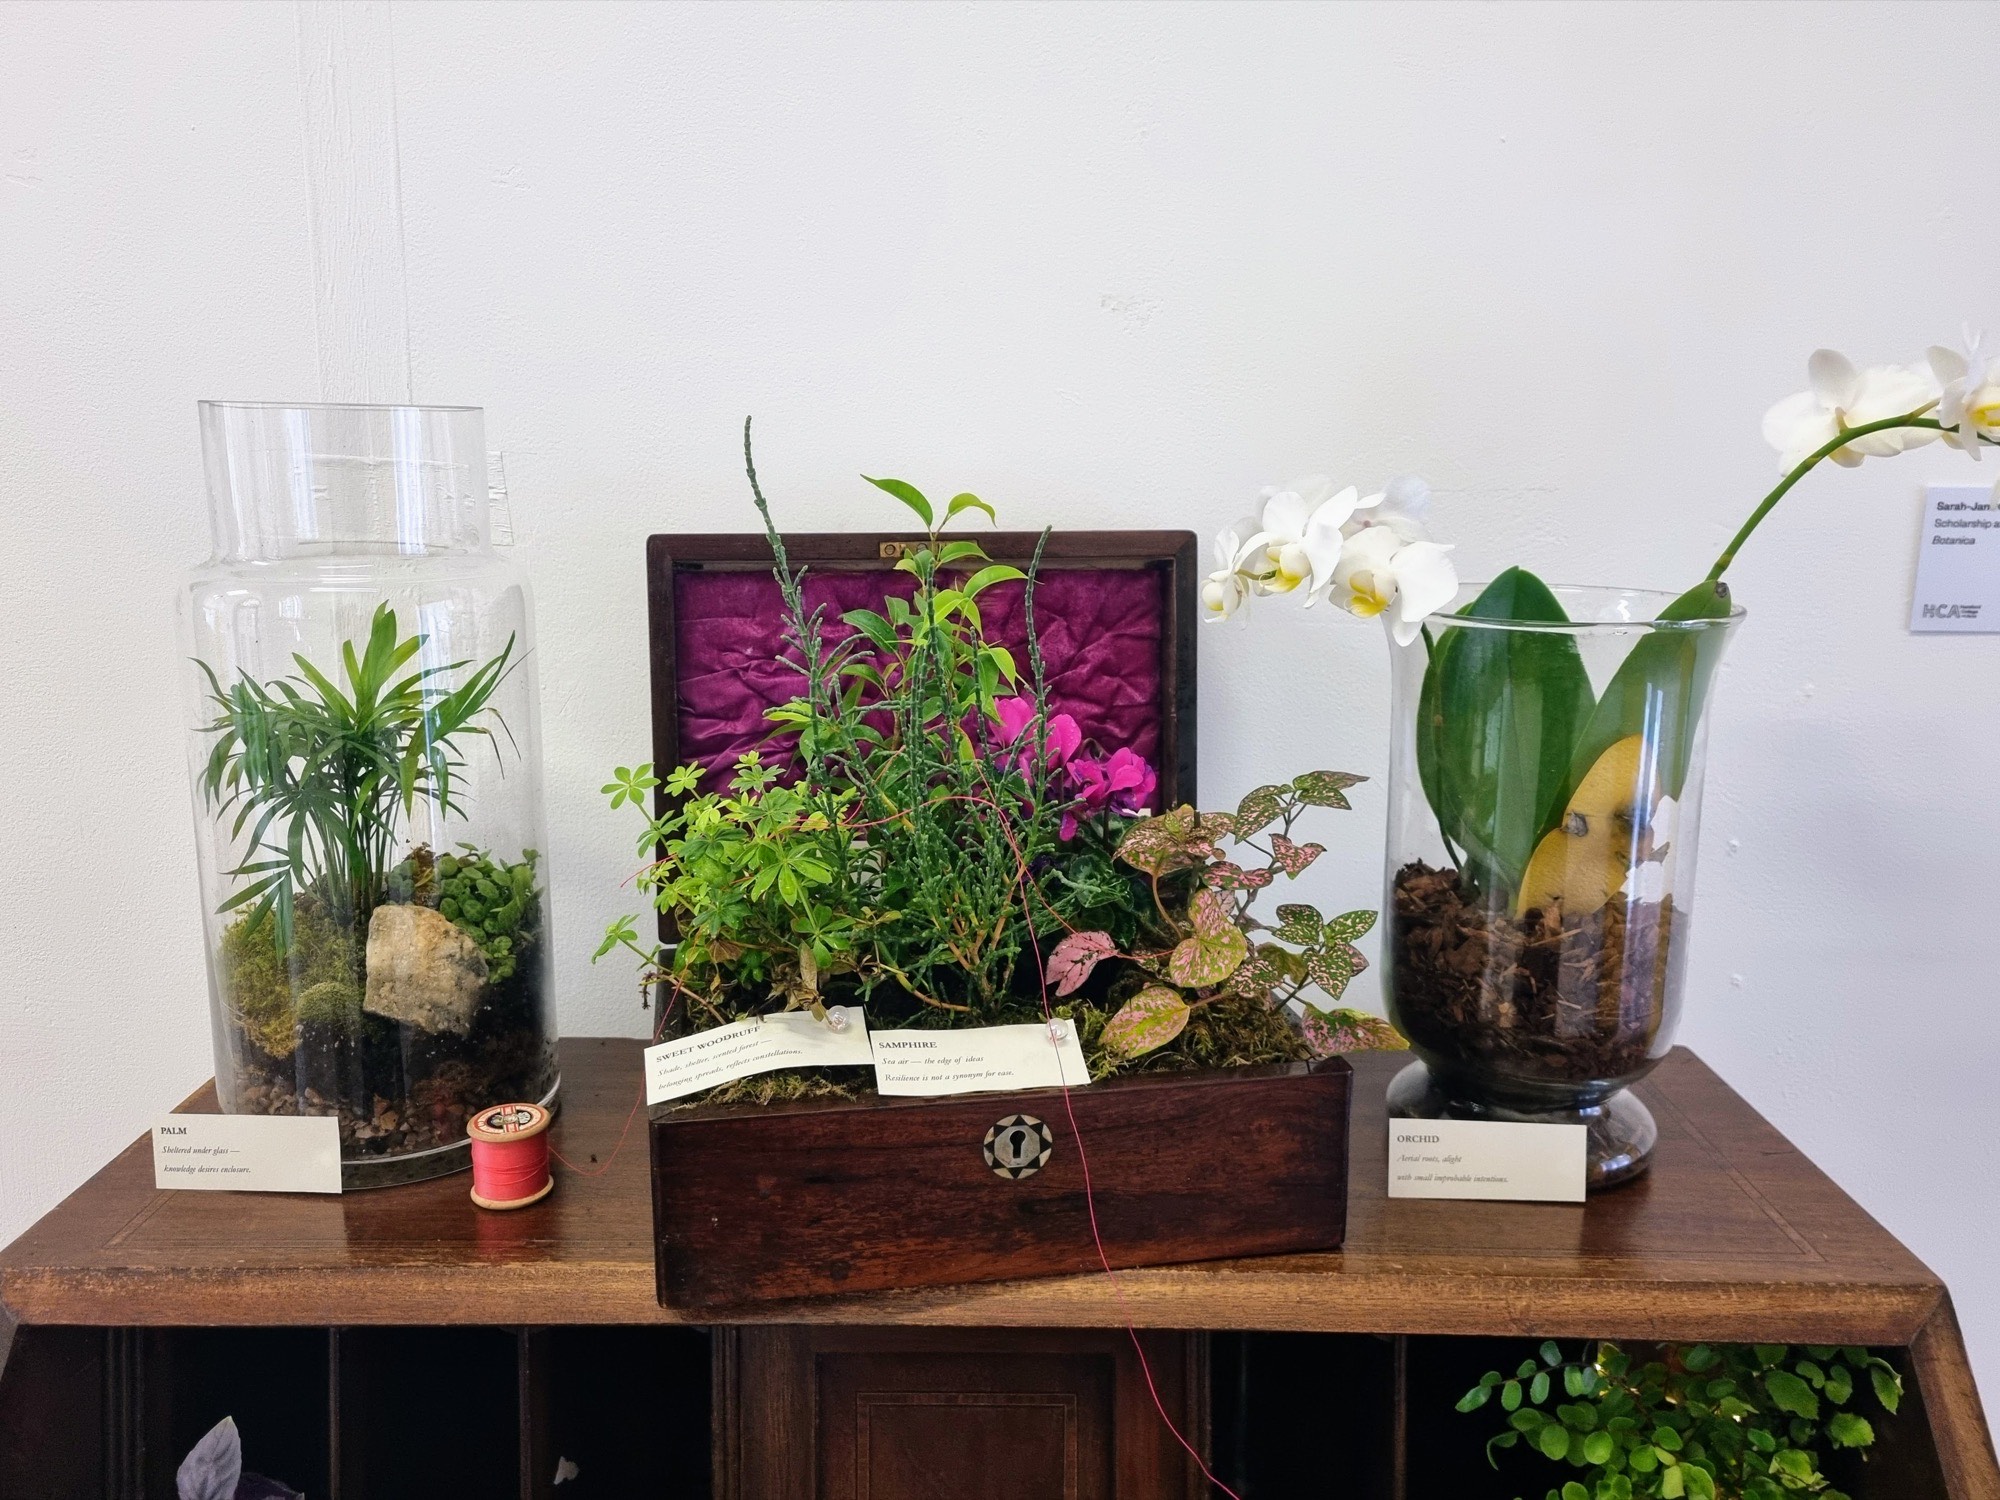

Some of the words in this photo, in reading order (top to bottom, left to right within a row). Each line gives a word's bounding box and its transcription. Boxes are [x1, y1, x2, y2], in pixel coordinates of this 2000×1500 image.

[1936, 501, 1991, 511] Sarah-Jan
[1934, 518, 1992, 530] Scholarship
[1932, 535, 1976, 545] Botanica
[1922, 604, 1960, 618] HCA
[656, 1046, 695, 1062] SWEET
[697, 1026, 761, 1050] WOODRUFF
[658, 1065, 682, 1077] Shade,
[685, 1056, 710, 1068] shelter,
[712, 1047, 737, 1060] scented
[736, 1040, 759, 1054] forest
[937, 1057, 952, 1067] edge
[954, 1056, 962, 1066] of
[658, 1076, 693, 1090] belonging
[694, 1066, 724, 1080] spreads,
[726, 1058, 750, 1070] reflects
[752, 1048, 803, 1062] constellations.
[885, 1074, 920, 1082] Resilience
[952, 1072, 983, 1081] synonym
[984, 1070, 996, 1079] for
[1397, 1135, 1440, 1143] ORCHID
[162, 1146, 192, 1154] Sheltered
[212, 1147, 228, 1156] glass
[1442, 1155, 1462, 1164] alight
[164, 1165, 196, 1175] knowledge
[1434, 1174, 1472, 1183] improbable
